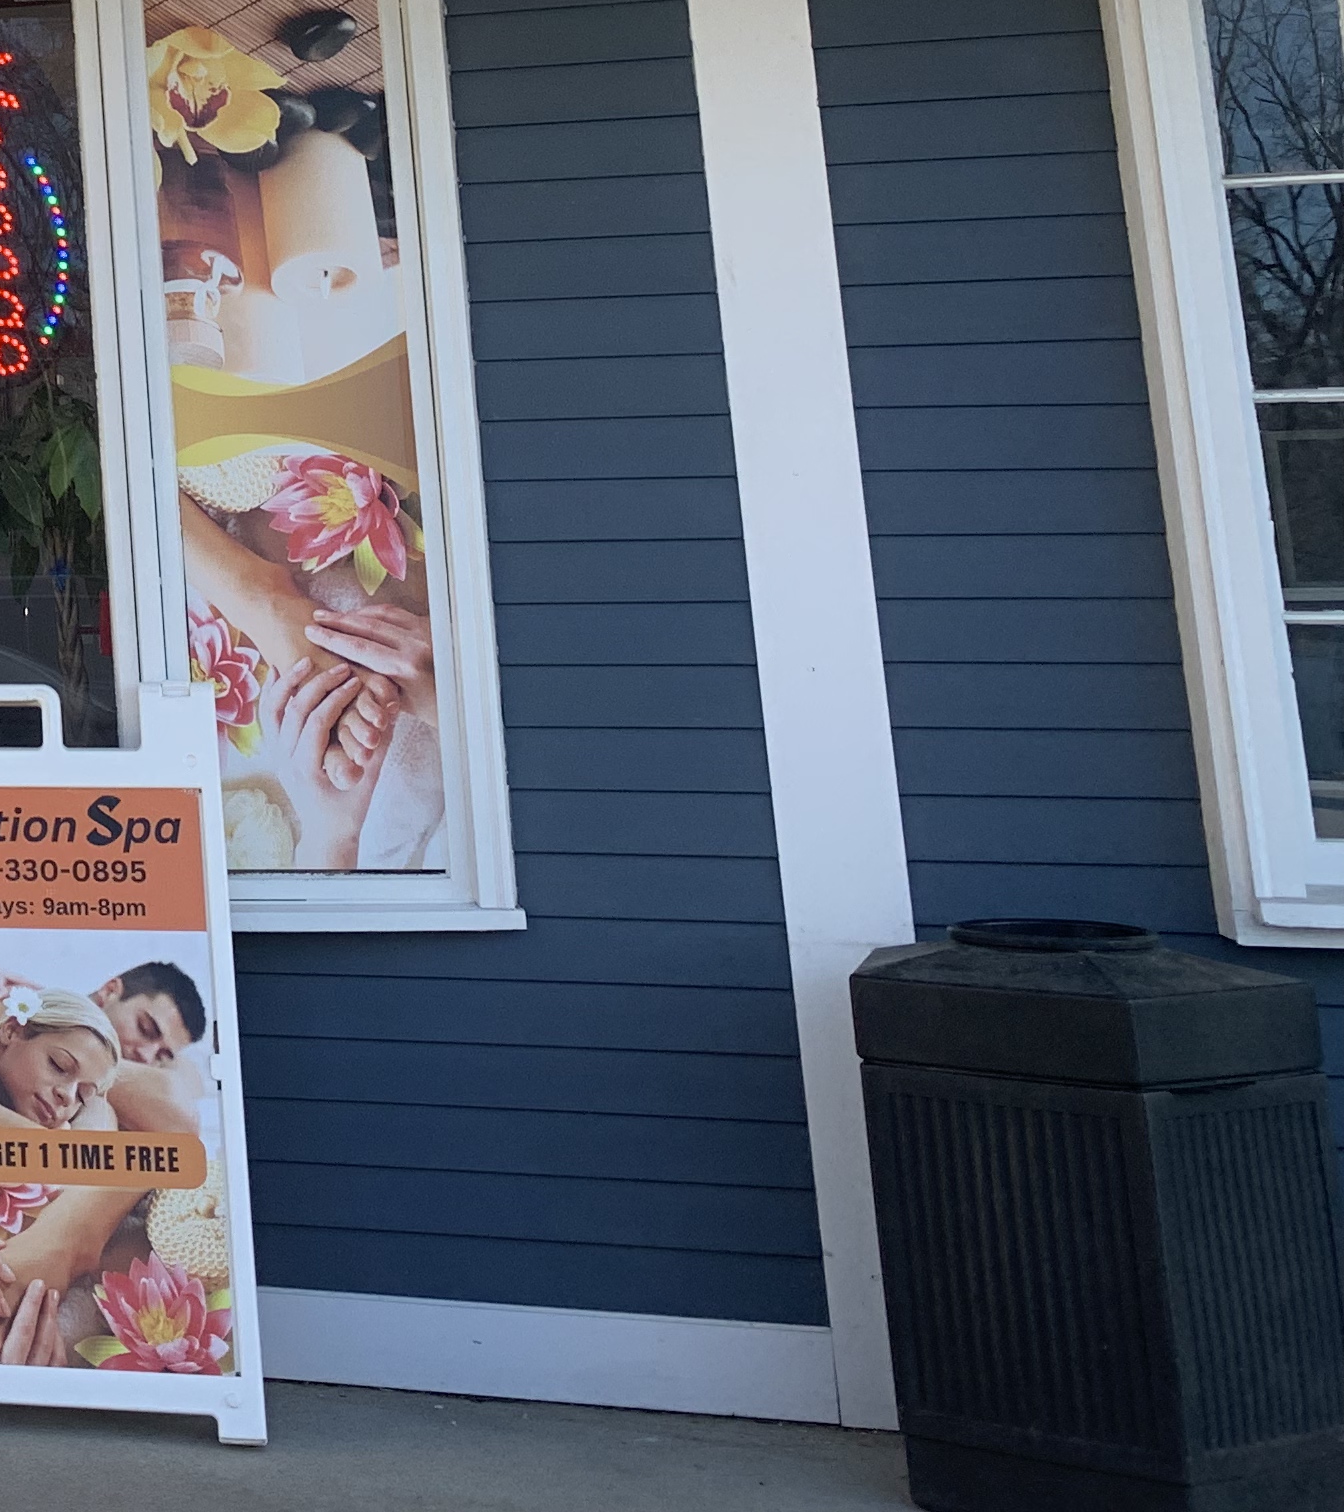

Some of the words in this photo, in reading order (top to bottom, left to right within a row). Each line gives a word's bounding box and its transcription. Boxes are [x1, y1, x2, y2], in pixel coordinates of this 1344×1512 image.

[86, 794, 181, 854] Spa
[42, 899, 147, 921] 9am-8pm
[38, 1143, 49, 1168] 1
[58, 1143, 116, 1171] TIME
[125, 1145, 180, 1173] FREE
